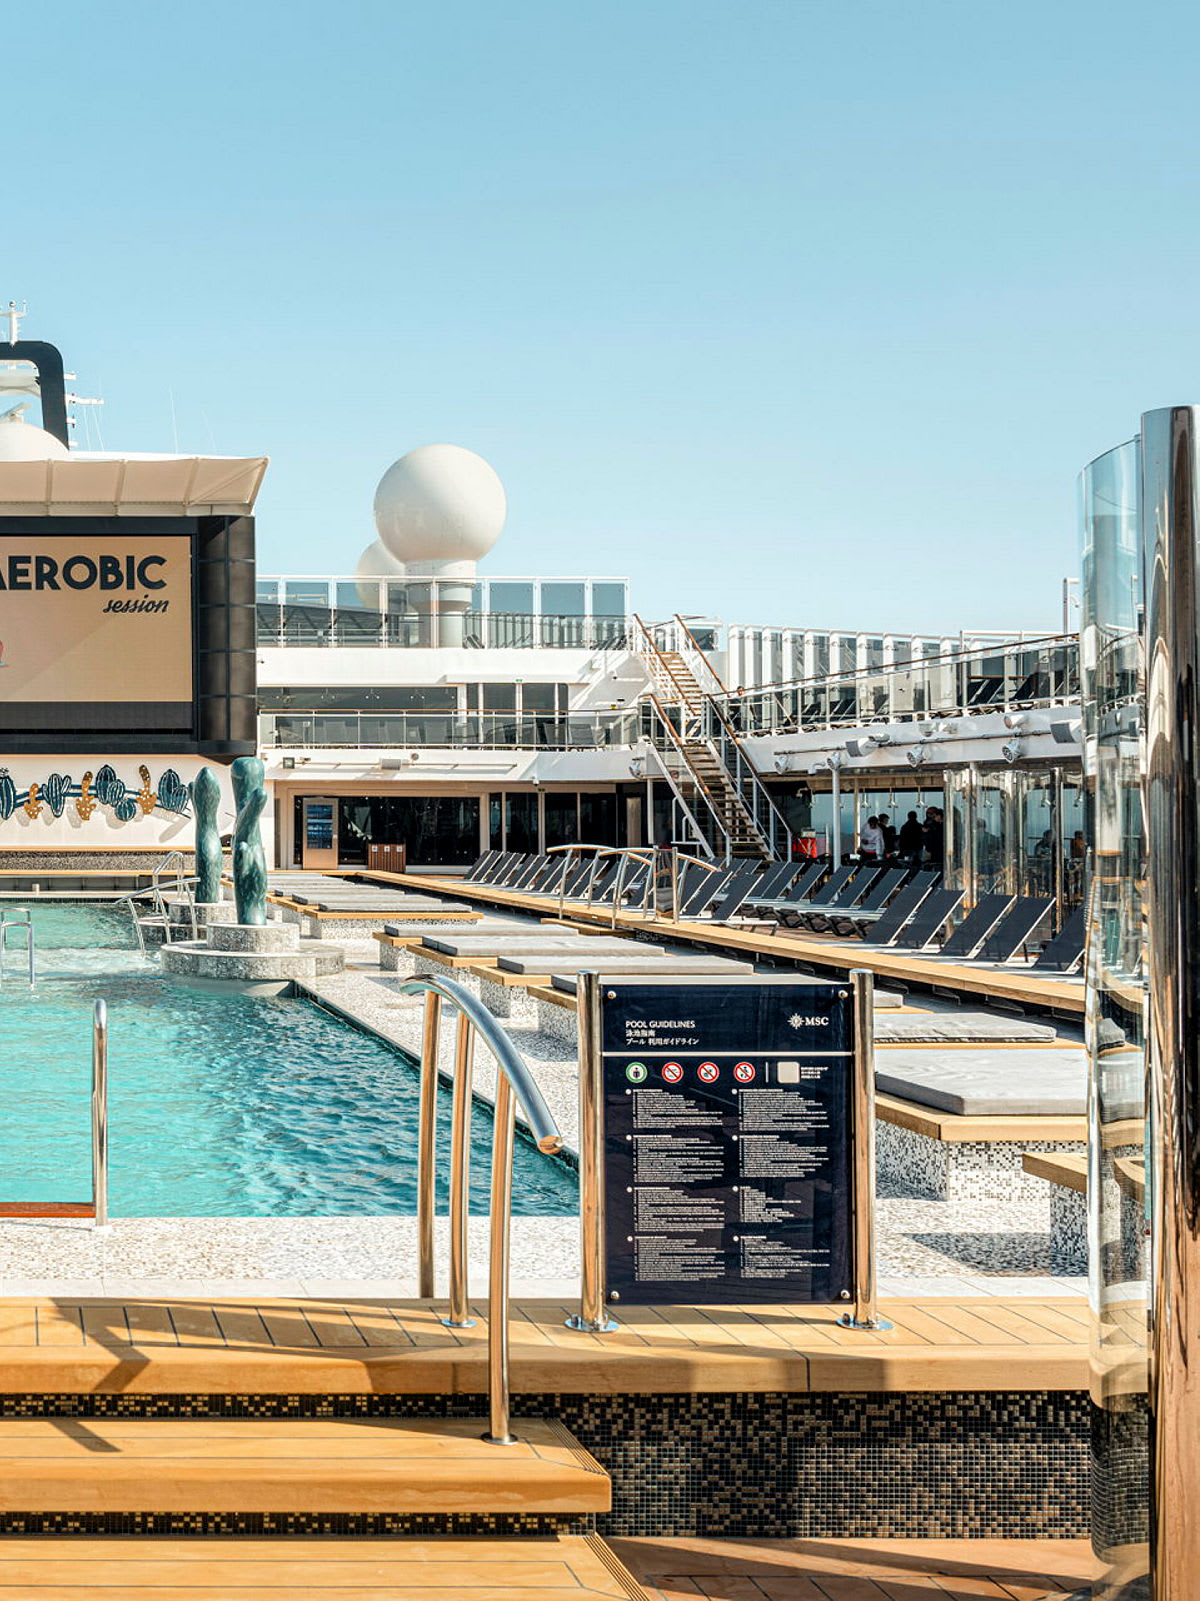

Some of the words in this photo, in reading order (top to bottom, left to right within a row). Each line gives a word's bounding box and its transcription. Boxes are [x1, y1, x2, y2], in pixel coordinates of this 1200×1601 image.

[102, 593, 170, 614] session
[625, 1020, 648, 1028] POOL
[649, 1020, 696, 1028] GUIDELINES
[805, 1016, 829, 1026] MSC
